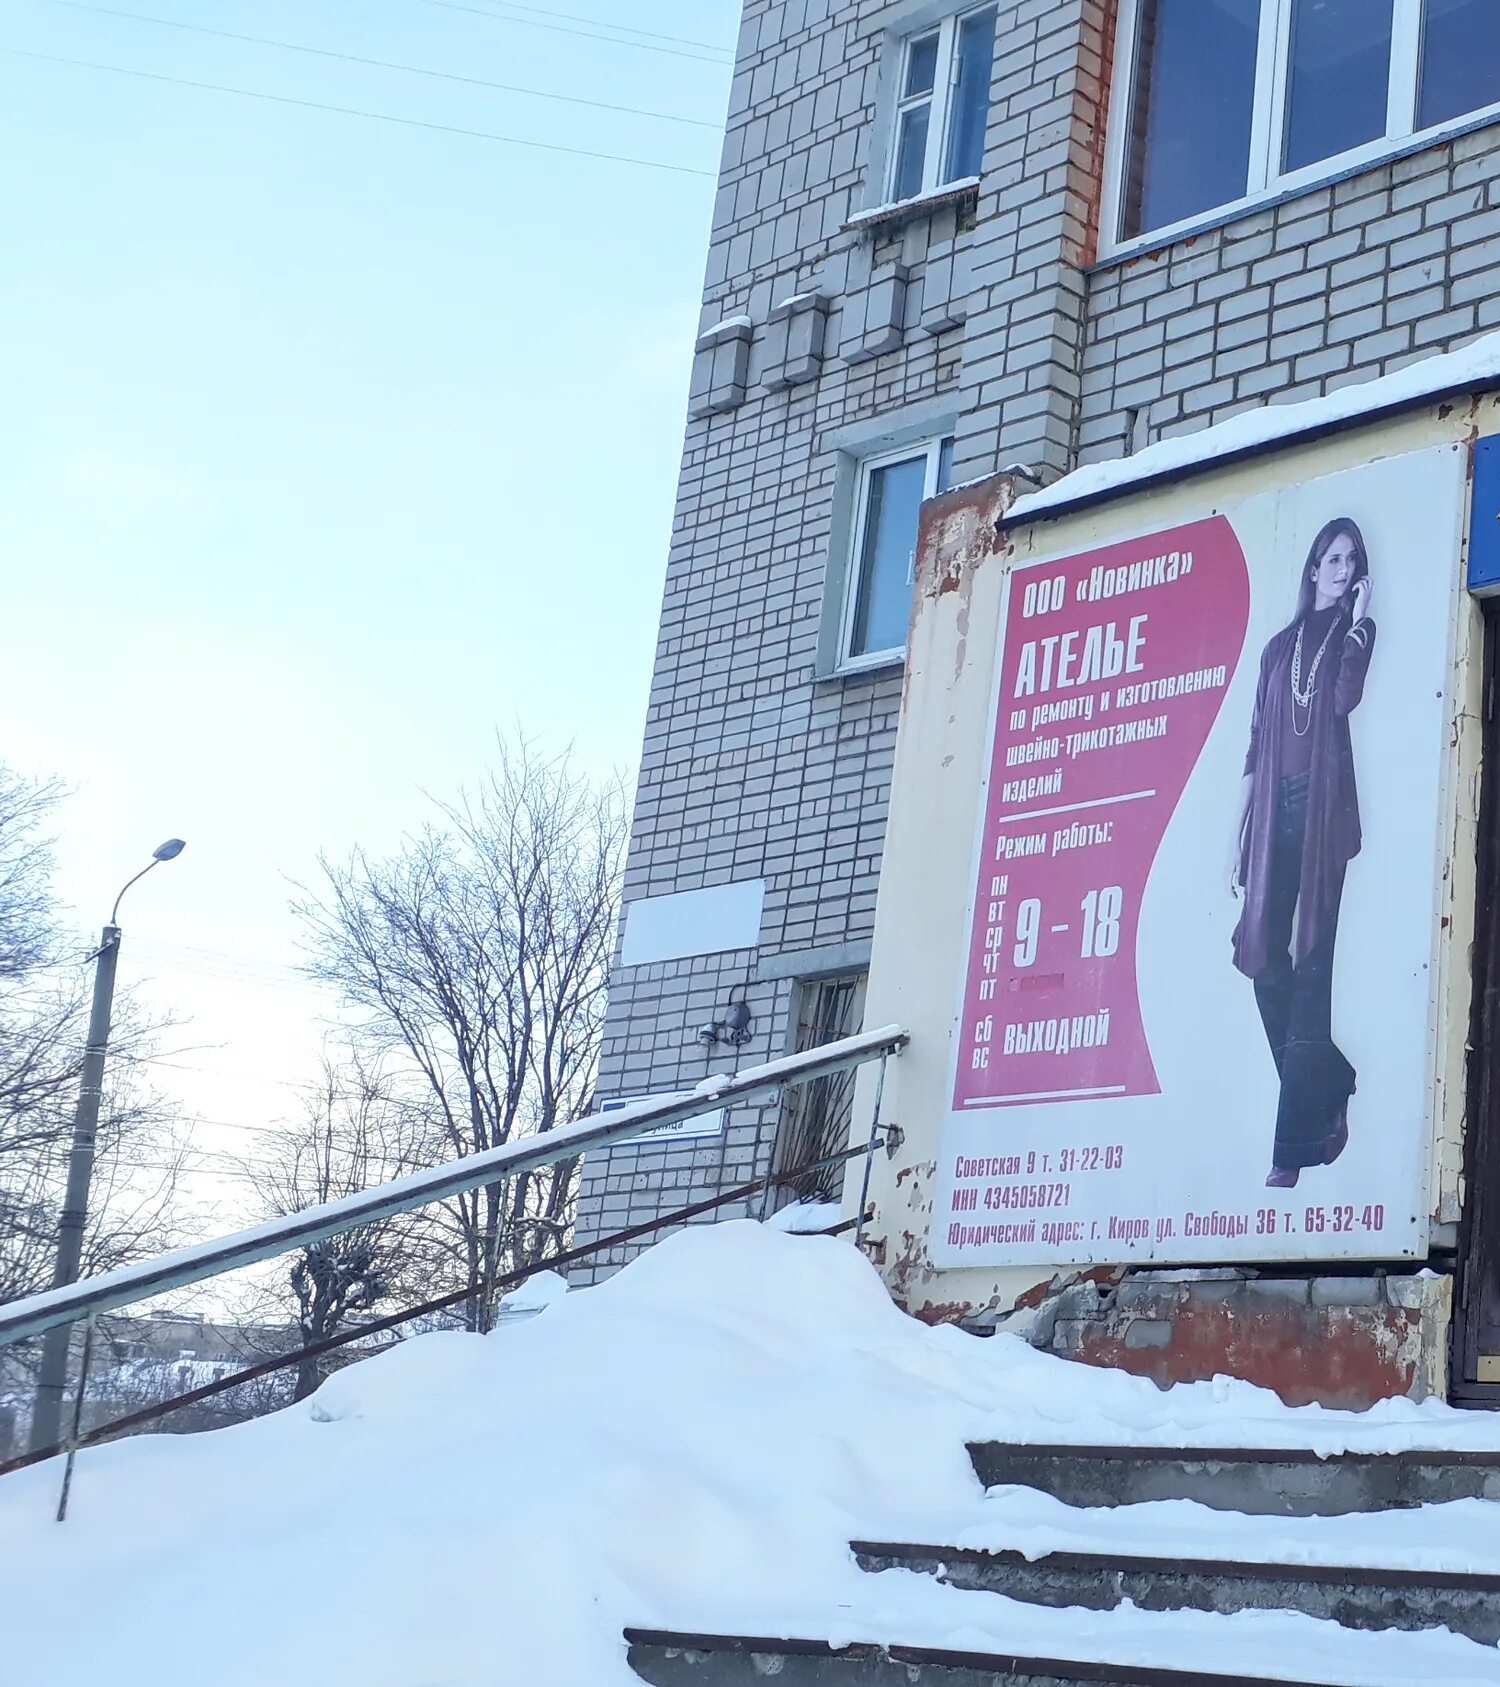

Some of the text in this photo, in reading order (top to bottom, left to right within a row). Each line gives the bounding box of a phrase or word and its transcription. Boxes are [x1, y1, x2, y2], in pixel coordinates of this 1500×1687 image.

[1022, 551, 1193, 618] ООО «Новинка»
[1013, 613, 1149, 698] АТЕЛЬЕ
[1010, 665, 1227, 732] по ремонту и изготовлению
[1006, 715, 1168, 767] швейно-трикотажных
[1002, 768, 1063, 803] изделий
[995, 821, 1114, 861] Режим работы:
[991, 875, 1009, 897] пн
[988, 901, 1006, 923] вт
[1013, 898, 1042, 968] 9
[1081, 885, 1123, 959] 18
[985, 926, 1003, 953] ср
[983, 952, 1000, 974] чт
[979, 978, 997, 1001] пт
[974, 1014, 993, 1043] сб
[1003, 1008, 1110, 1055] ВЫХОДНОЙ
[971, 1047, 990, 1070] вс
[955, 1145, 1124, 1179] Советская 9 т. 31-22-03
[951, 1183, 1071, 1211] ИНН 4345058721
[948, 1204, 1385, 1250] Юридический адрес: г. Киров ул. Свободы 36 т. 65-32-40
